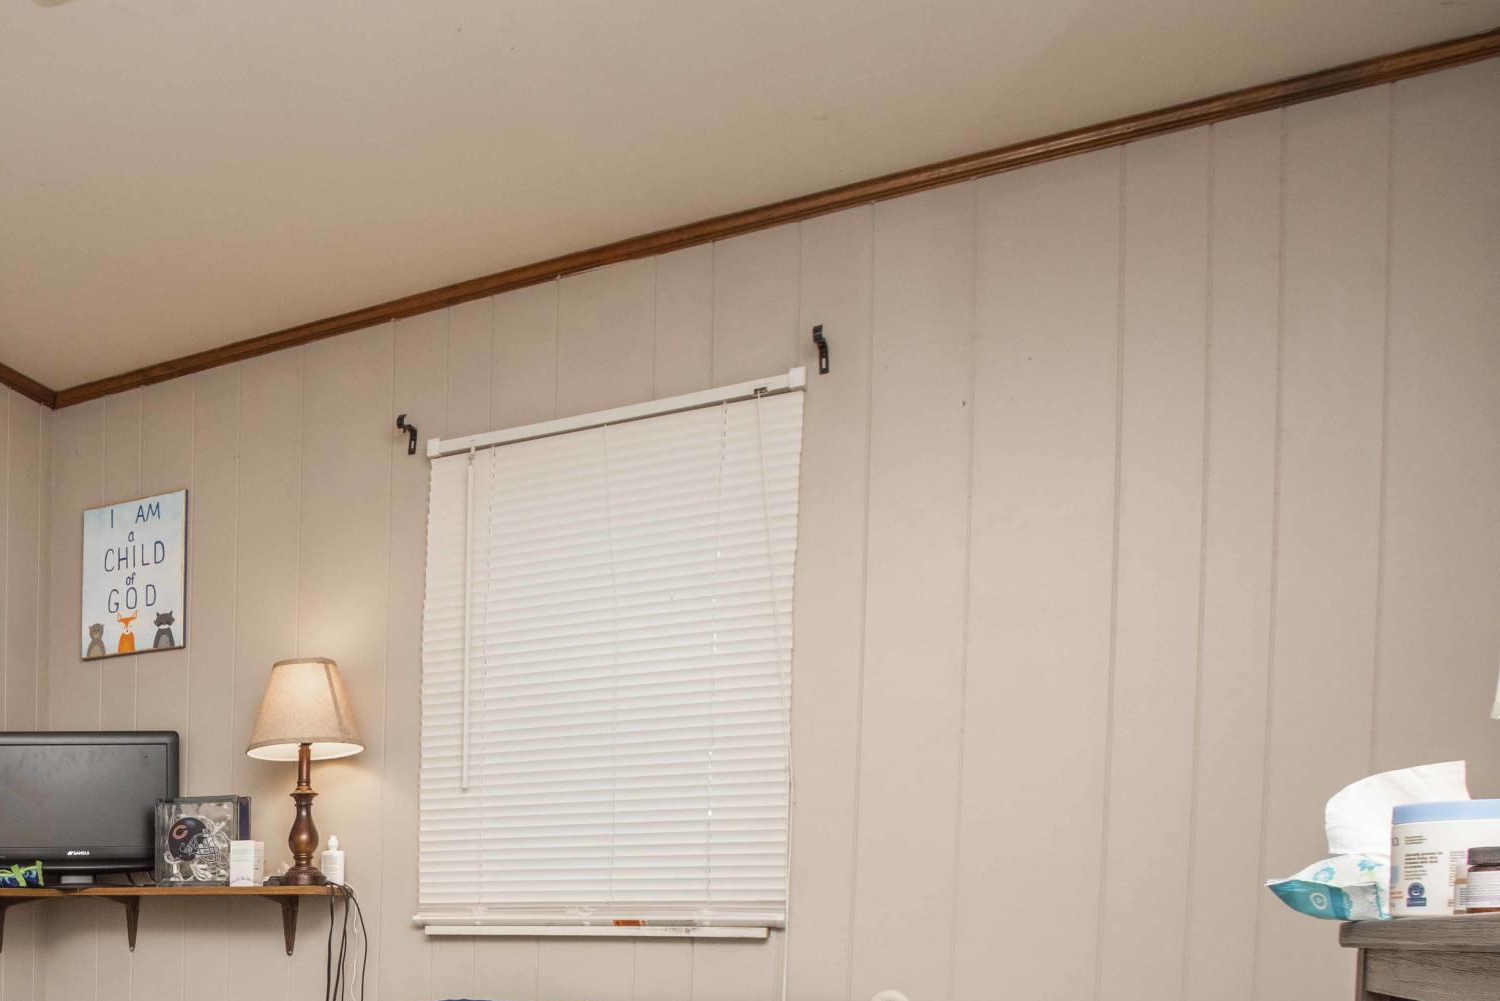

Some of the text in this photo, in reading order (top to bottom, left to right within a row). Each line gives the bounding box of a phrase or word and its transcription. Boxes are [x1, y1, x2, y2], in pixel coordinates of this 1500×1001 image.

[110, 502, 161, 529] I AM
[128, 531, 135, 542] a
[104, 540, 166, 572] CHILD
[125, 572, 137, 586] of
[108, 584, 157, 613] GOD
